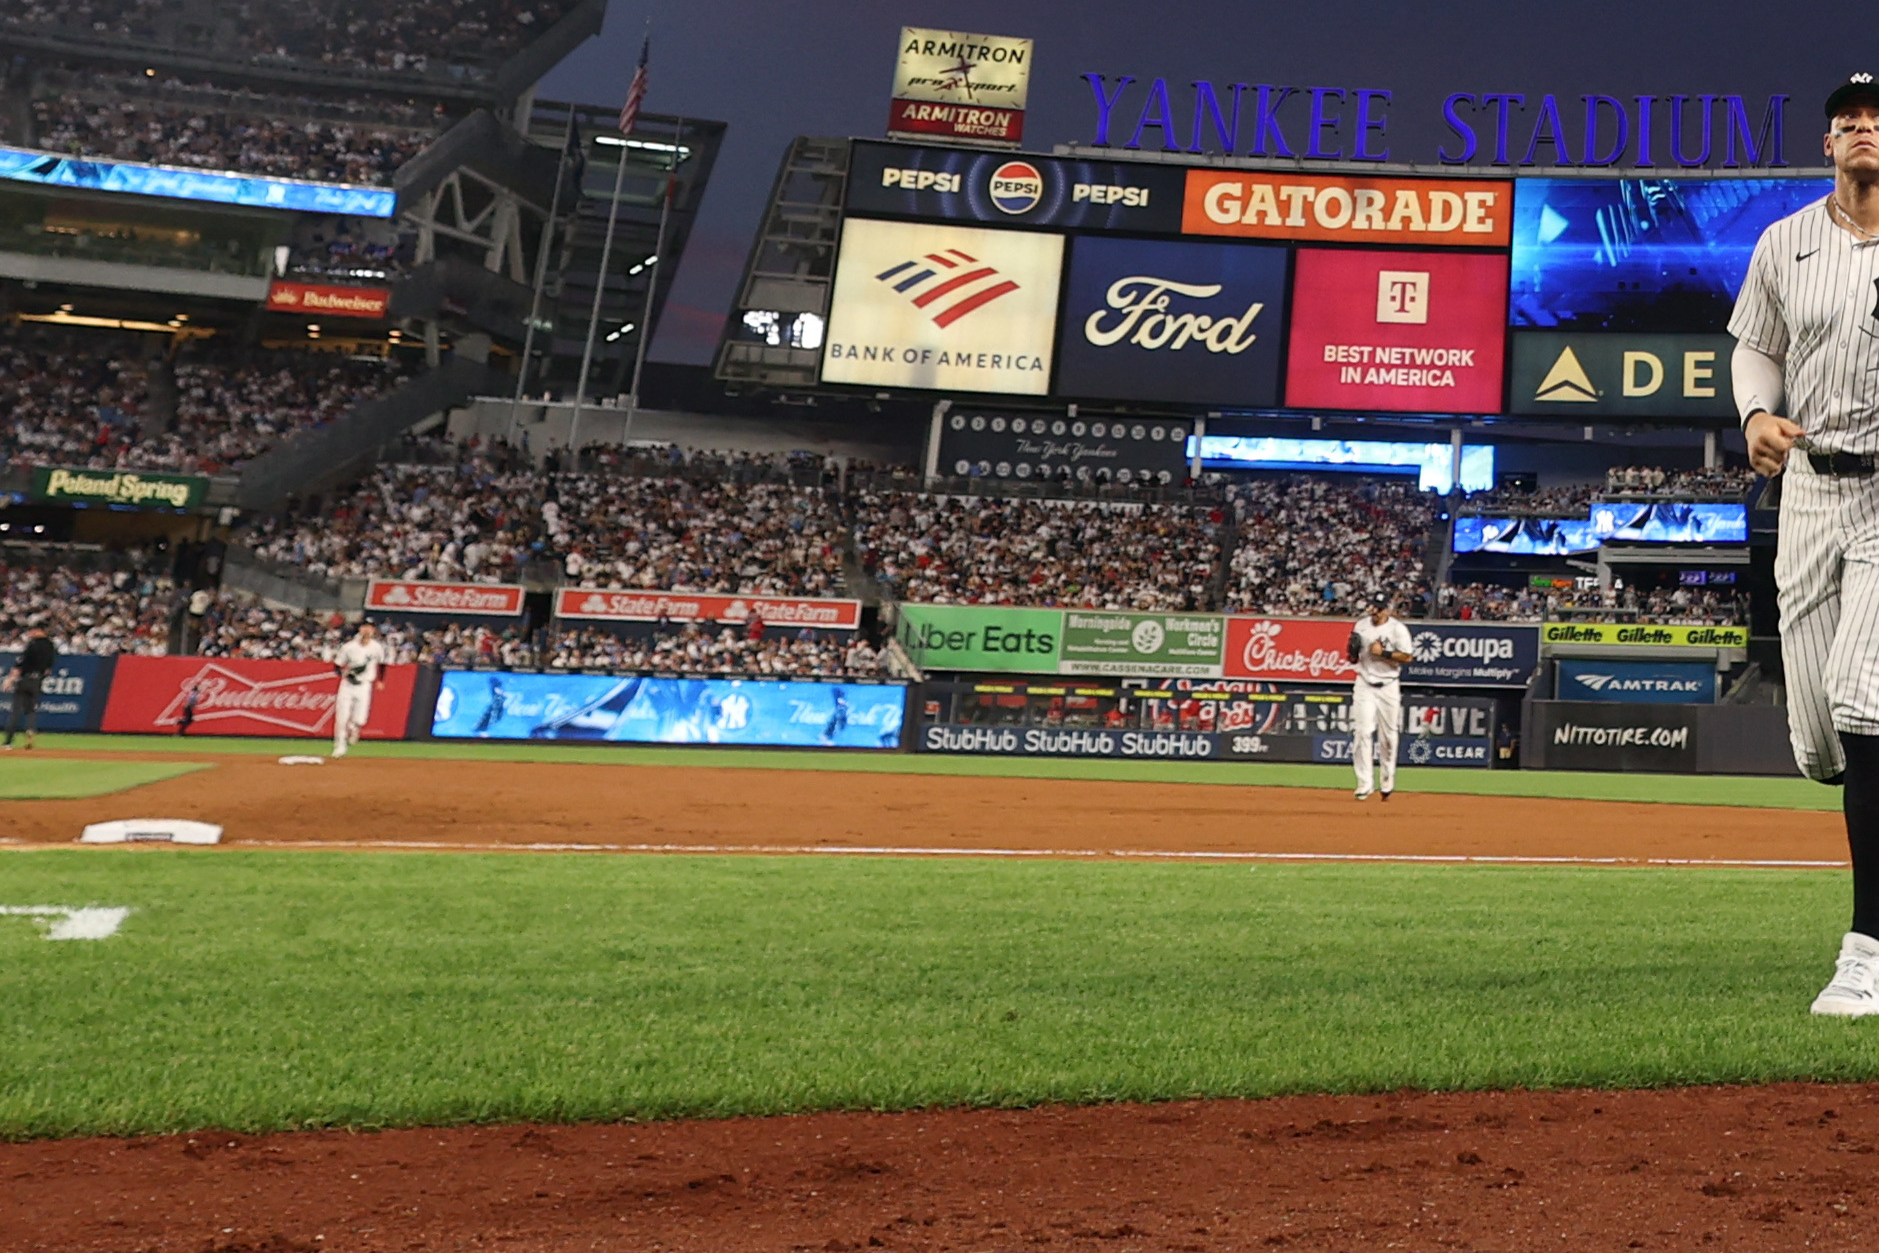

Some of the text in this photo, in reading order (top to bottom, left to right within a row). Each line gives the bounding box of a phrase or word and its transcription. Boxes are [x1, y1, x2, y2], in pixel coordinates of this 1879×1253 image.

[905, 38, 1025, 64] ARMITRON
[902, 103, 1011, 127] ARMITRON
[1081, 72, 1791, 169] YANKEE STADIUM
[953, 123, 1008, 137] WATCHES
[882, 167, 961, 193] PEPSI
[993, 180, 1039, 195] PEPSI
[1072, 183, 1149, 207] PEPSI
[1204, 182, 1496, 233] GATORADE
[303, 290, 384, 311] Budweiser
[1084, 276, 1265, 355] Ford
[830, 344, 1044, 372] BANK OF AMERICA
[1325, 345, 1475, 369] BEST NETWORK
[1340, 365, 1455, 388] IN AMERICA
[46, 468, 190, 507] Poland Spring
[412, 587, 510, 610] State Farm
[907, 622, 1054, 655] Uber Eats
[1187, 632, 1219, 648] Circle
[1548, 626, 1603, 643] Gillette
[1616, 628, 1673, 645] Gillette
[1687, 629, 1743, 646] Gillette
[1443, 635, 1514, 664] coupa
[196, 677, 338, 712] Budweiser
[1607, 679, 1698, 693] AMTRAK
[926, 726, 1018, 752] StubHub
[1024, 730, 1115, 754] StubHub
[1121, 733, 1212, 757] StubHub
[1554, 723, 1689, 749] NITTOTIRE.COM
[1435, 746, 1486, 759] CLEAR
